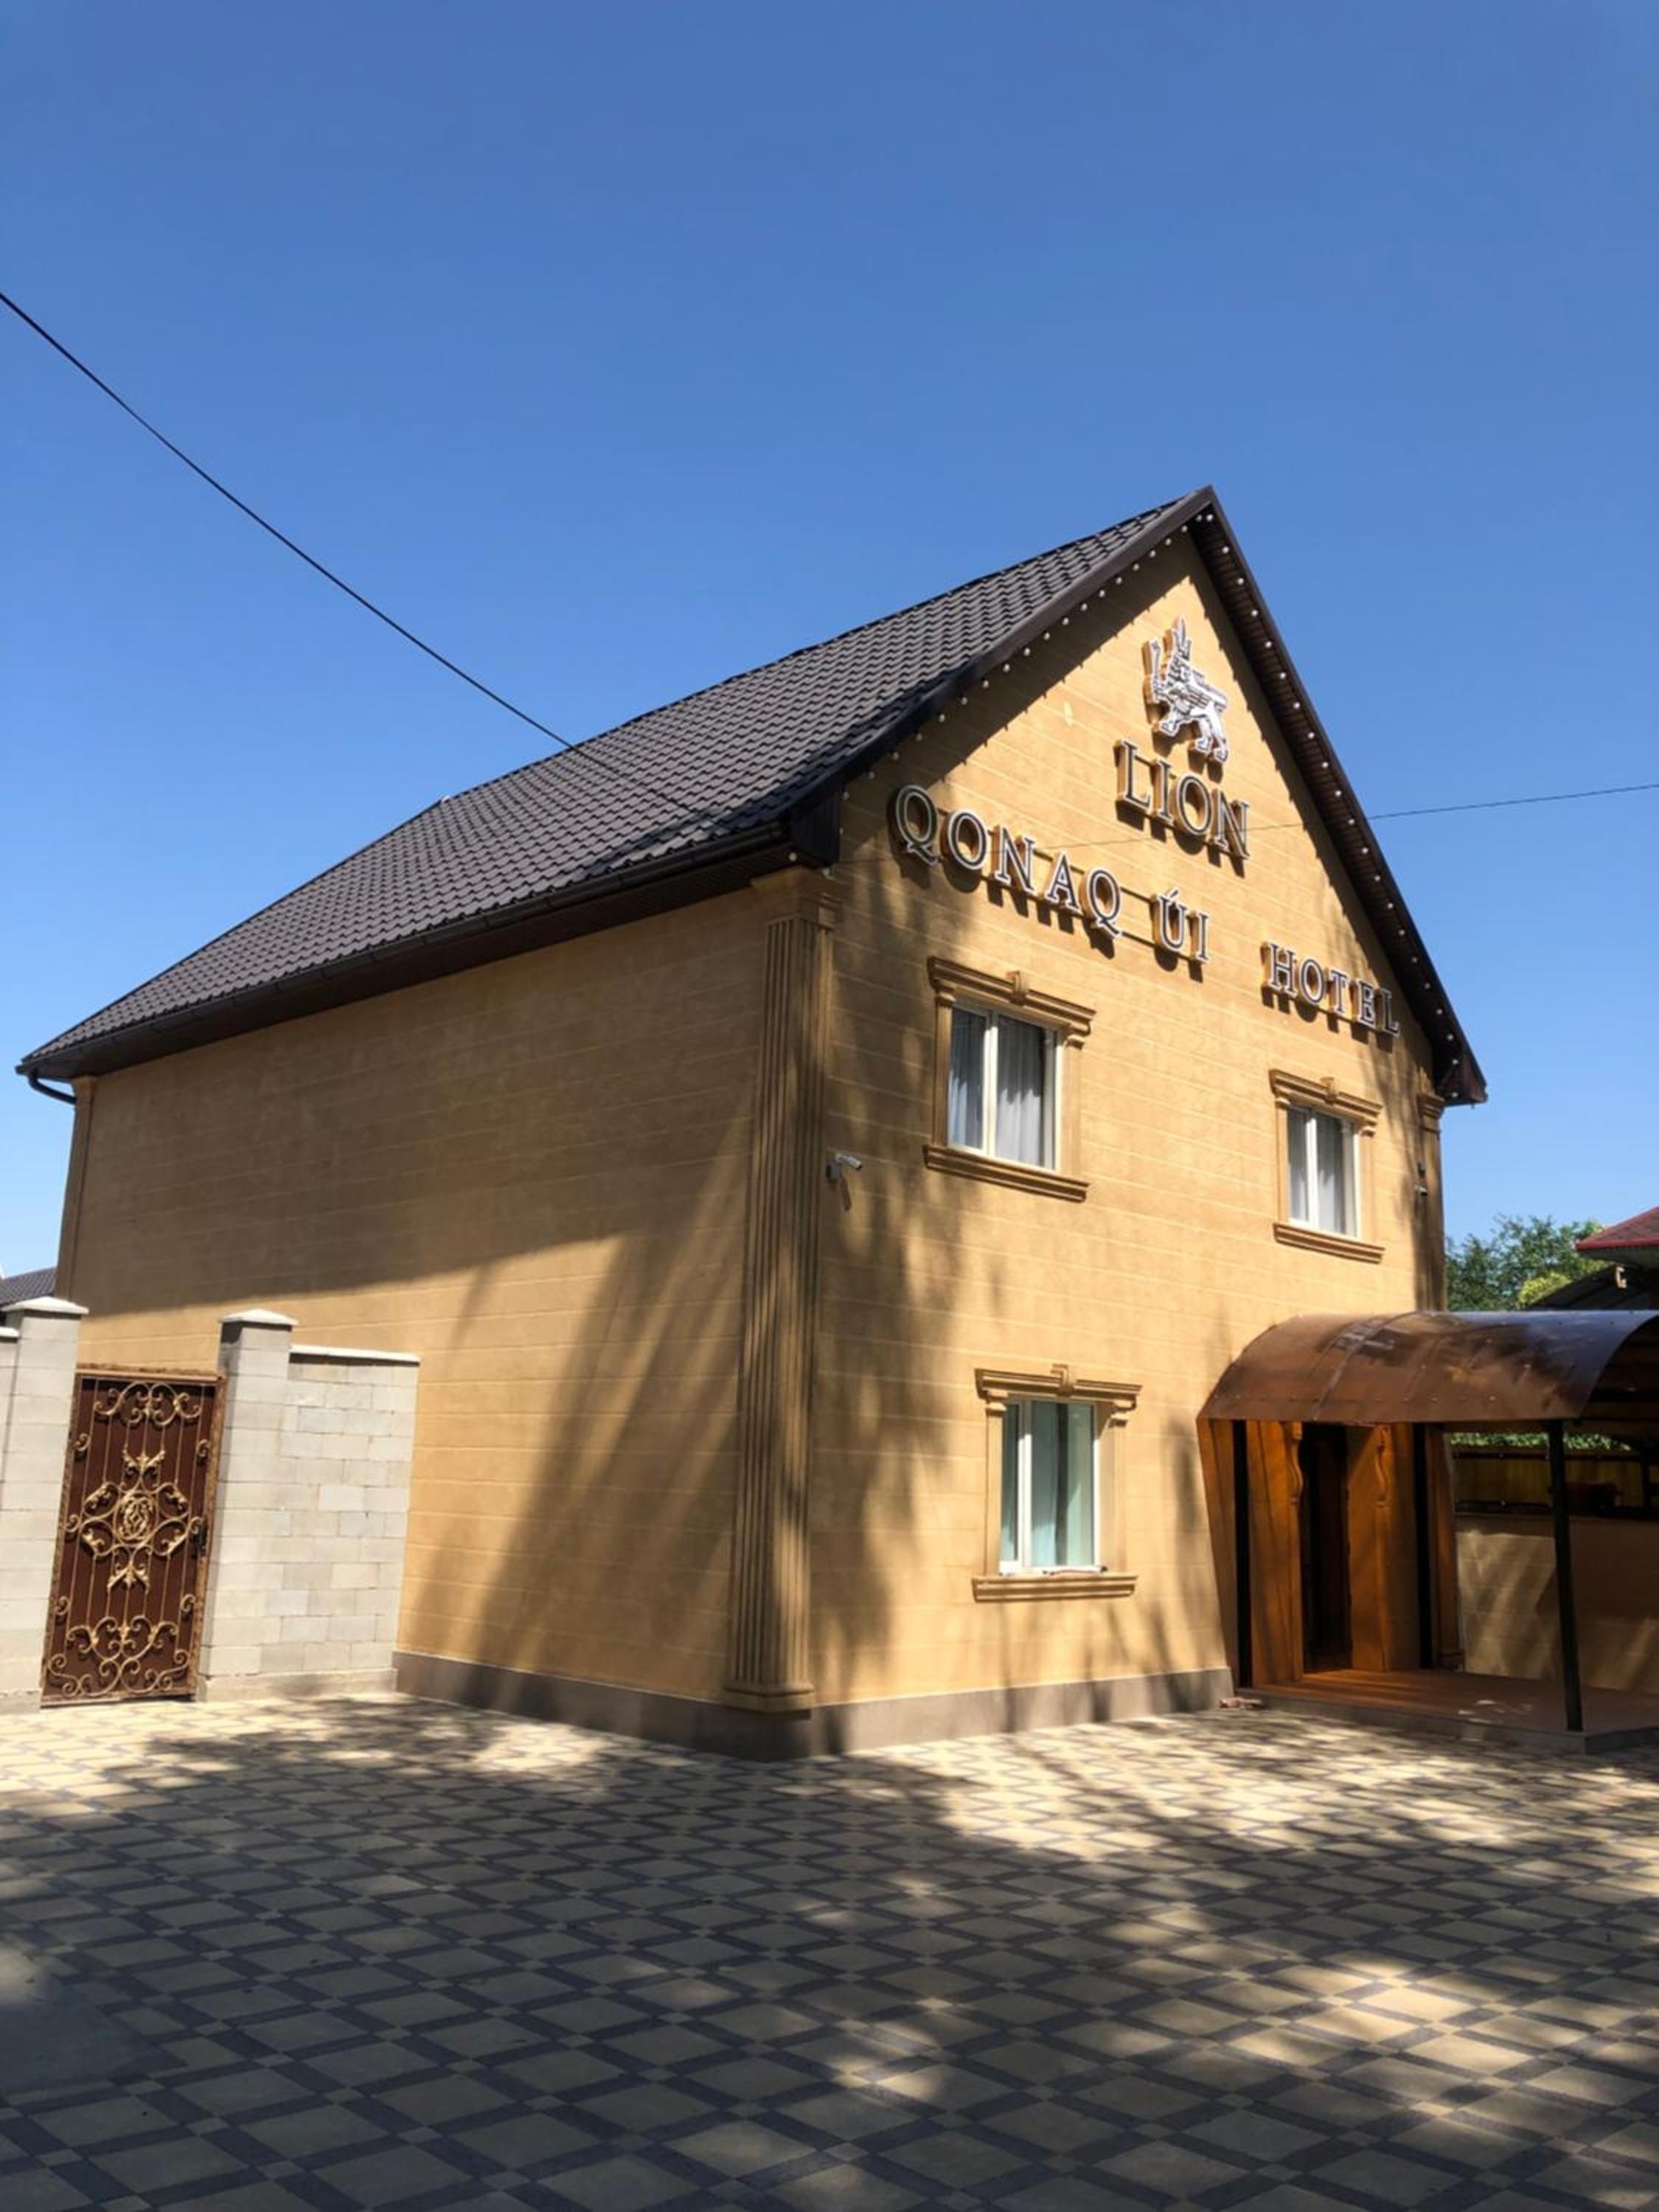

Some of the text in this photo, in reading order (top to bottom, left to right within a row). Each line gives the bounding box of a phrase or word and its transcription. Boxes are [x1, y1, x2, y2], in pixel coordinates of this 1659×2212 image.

[1119, 738, 1251, 859] LION
[894, 785, 1400, 1038] QONAQ ÚI HOTEL
